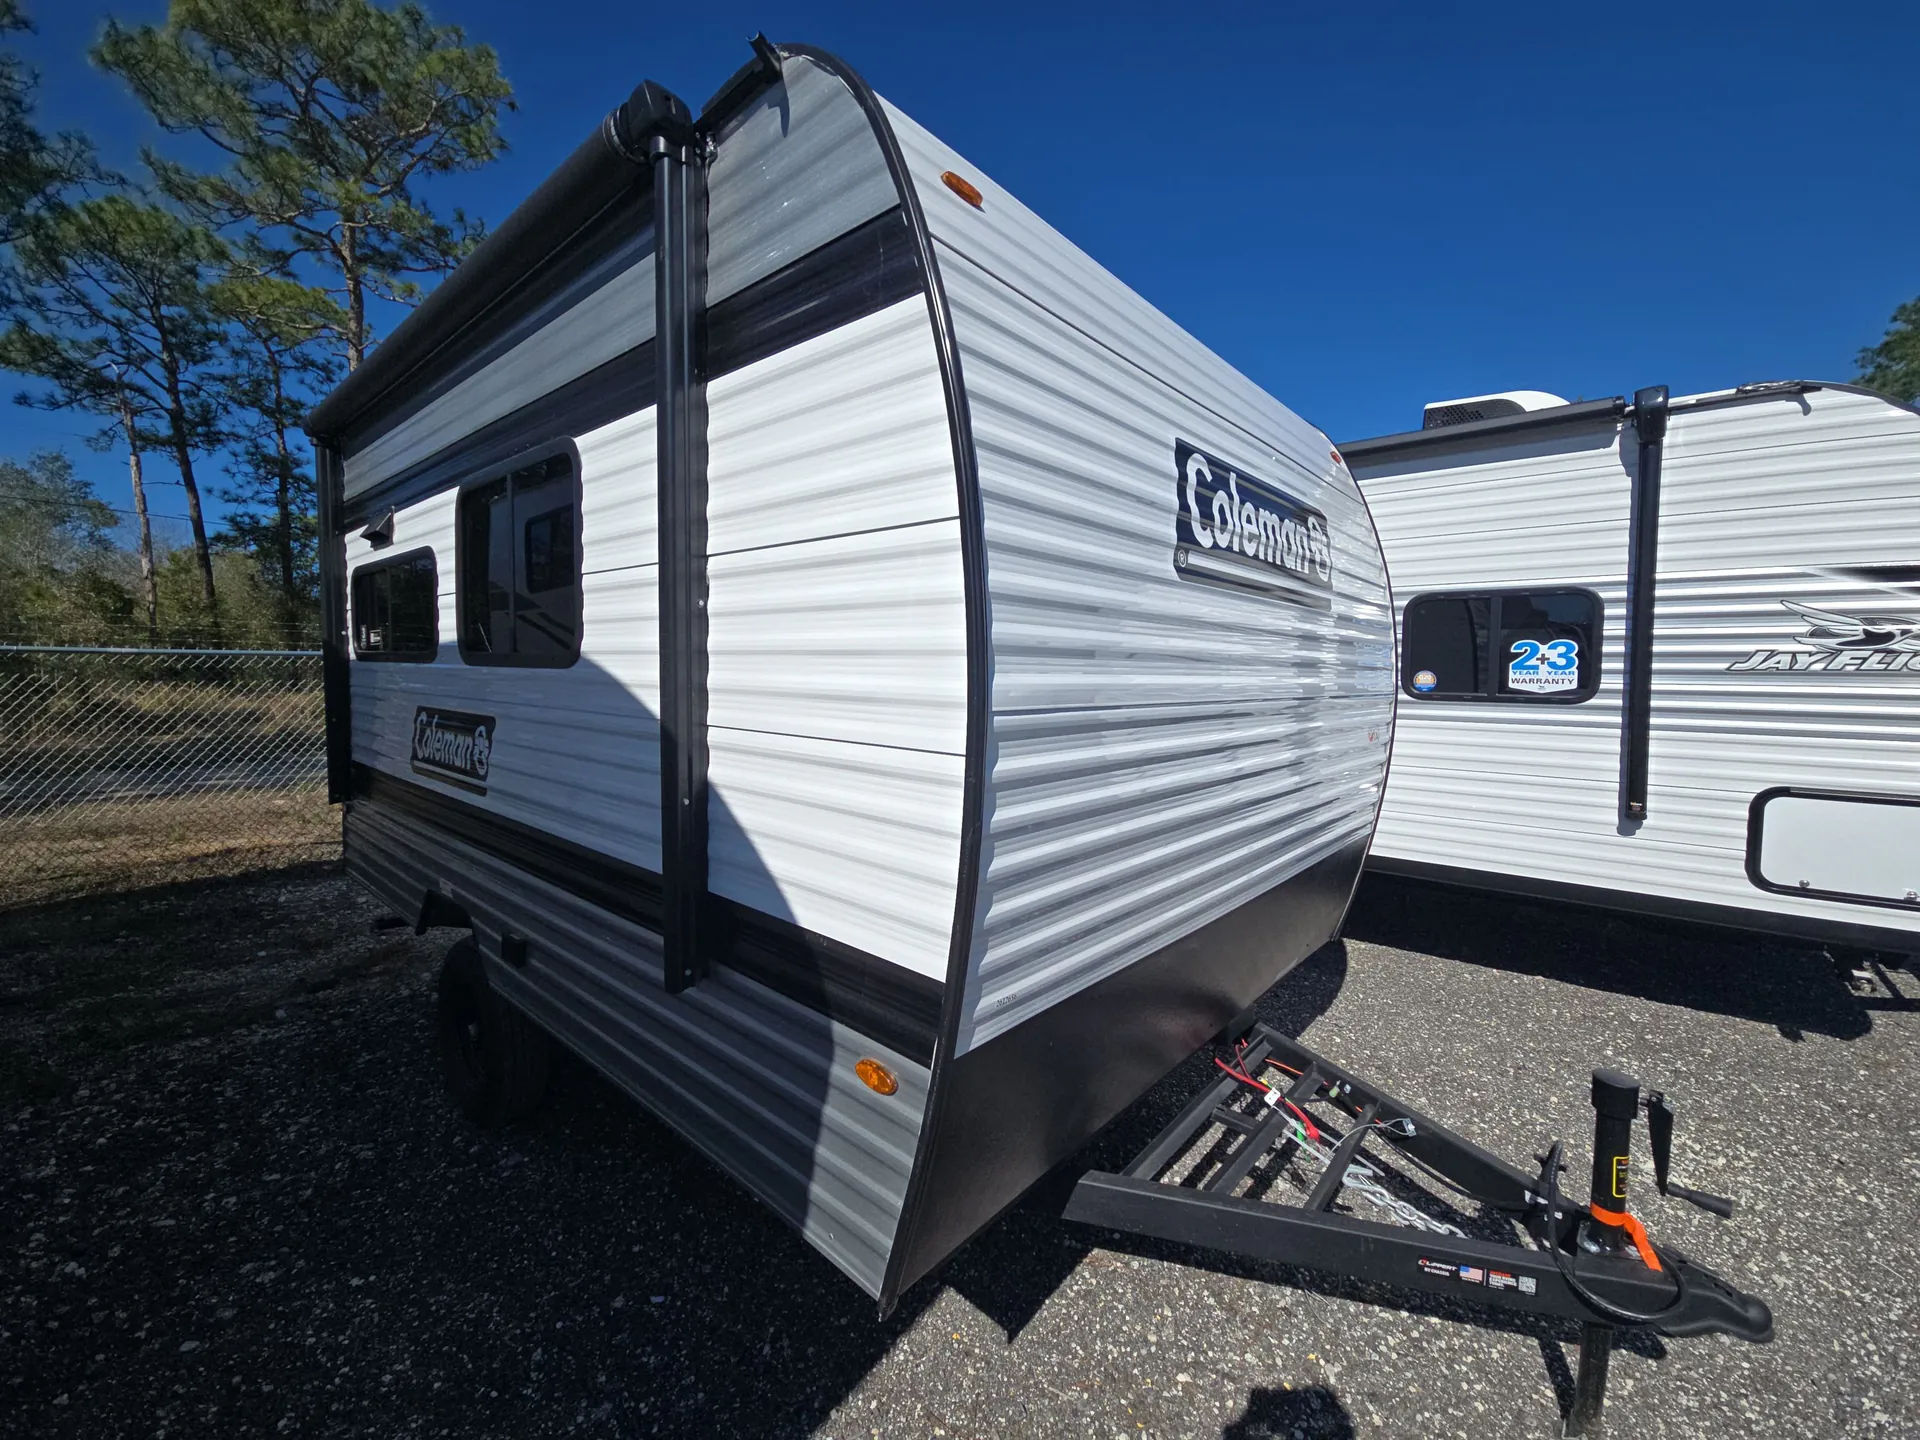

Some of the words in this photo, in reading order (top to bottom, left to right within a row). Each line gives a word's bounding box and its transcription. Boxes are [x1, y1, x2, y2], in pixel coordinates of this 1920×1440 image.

[1186, 453, 1310, 574] Coleman
[1511, 677, 1575, 685] WARRANTY
[1726, 650, 1829, 672] JAY
[415, 712, 474, 770] Coleman
